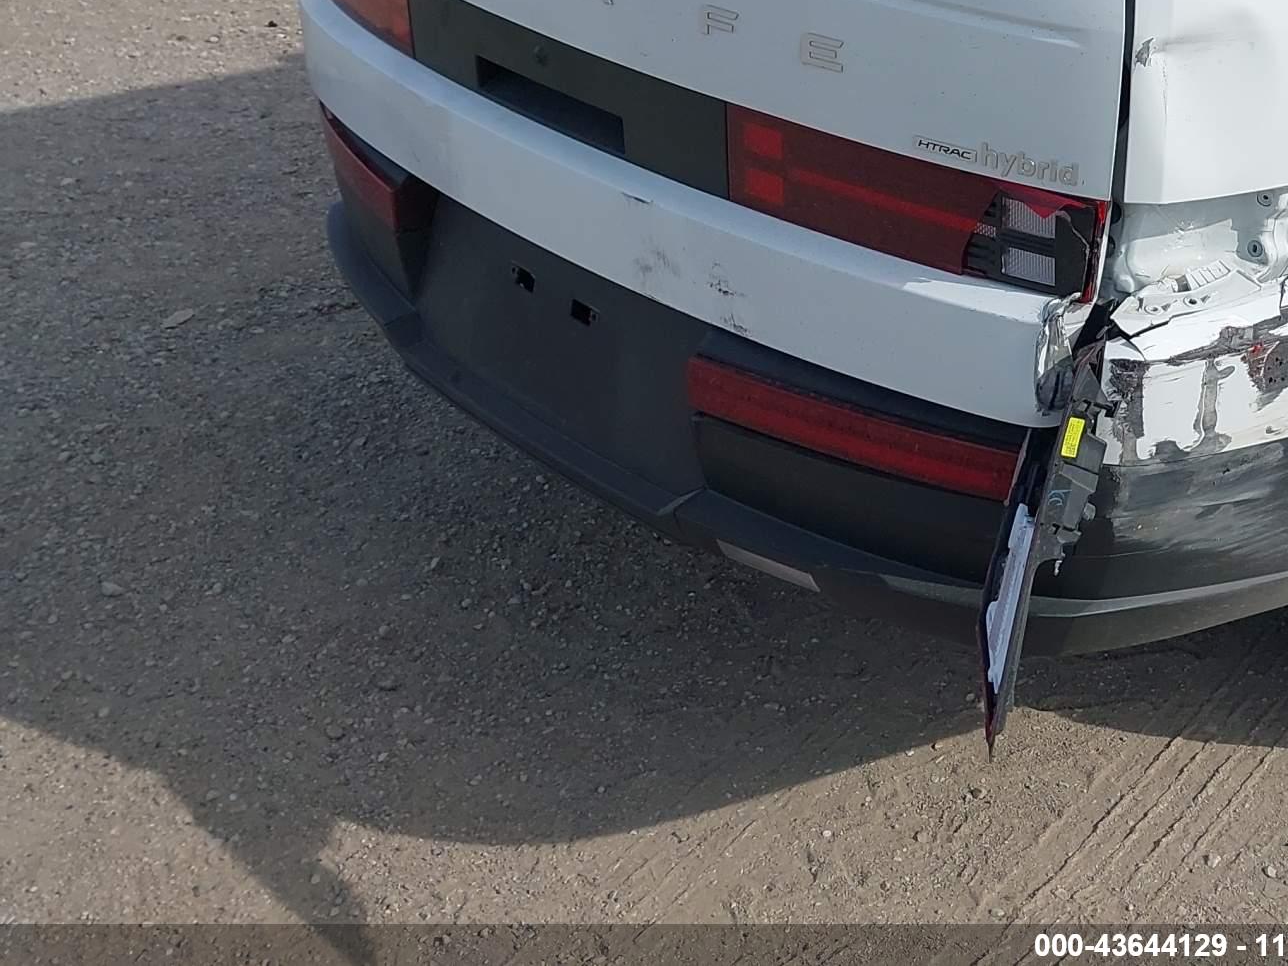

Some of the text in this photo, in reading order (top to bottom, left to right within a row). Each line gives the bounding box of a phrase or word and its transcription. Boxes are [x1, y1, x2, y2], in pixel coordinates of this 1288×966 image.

[701, 3, 845, 75] FE
[917, 138, 973, 161] HTRAC
[981, 141, 1080, 187] hybrid
